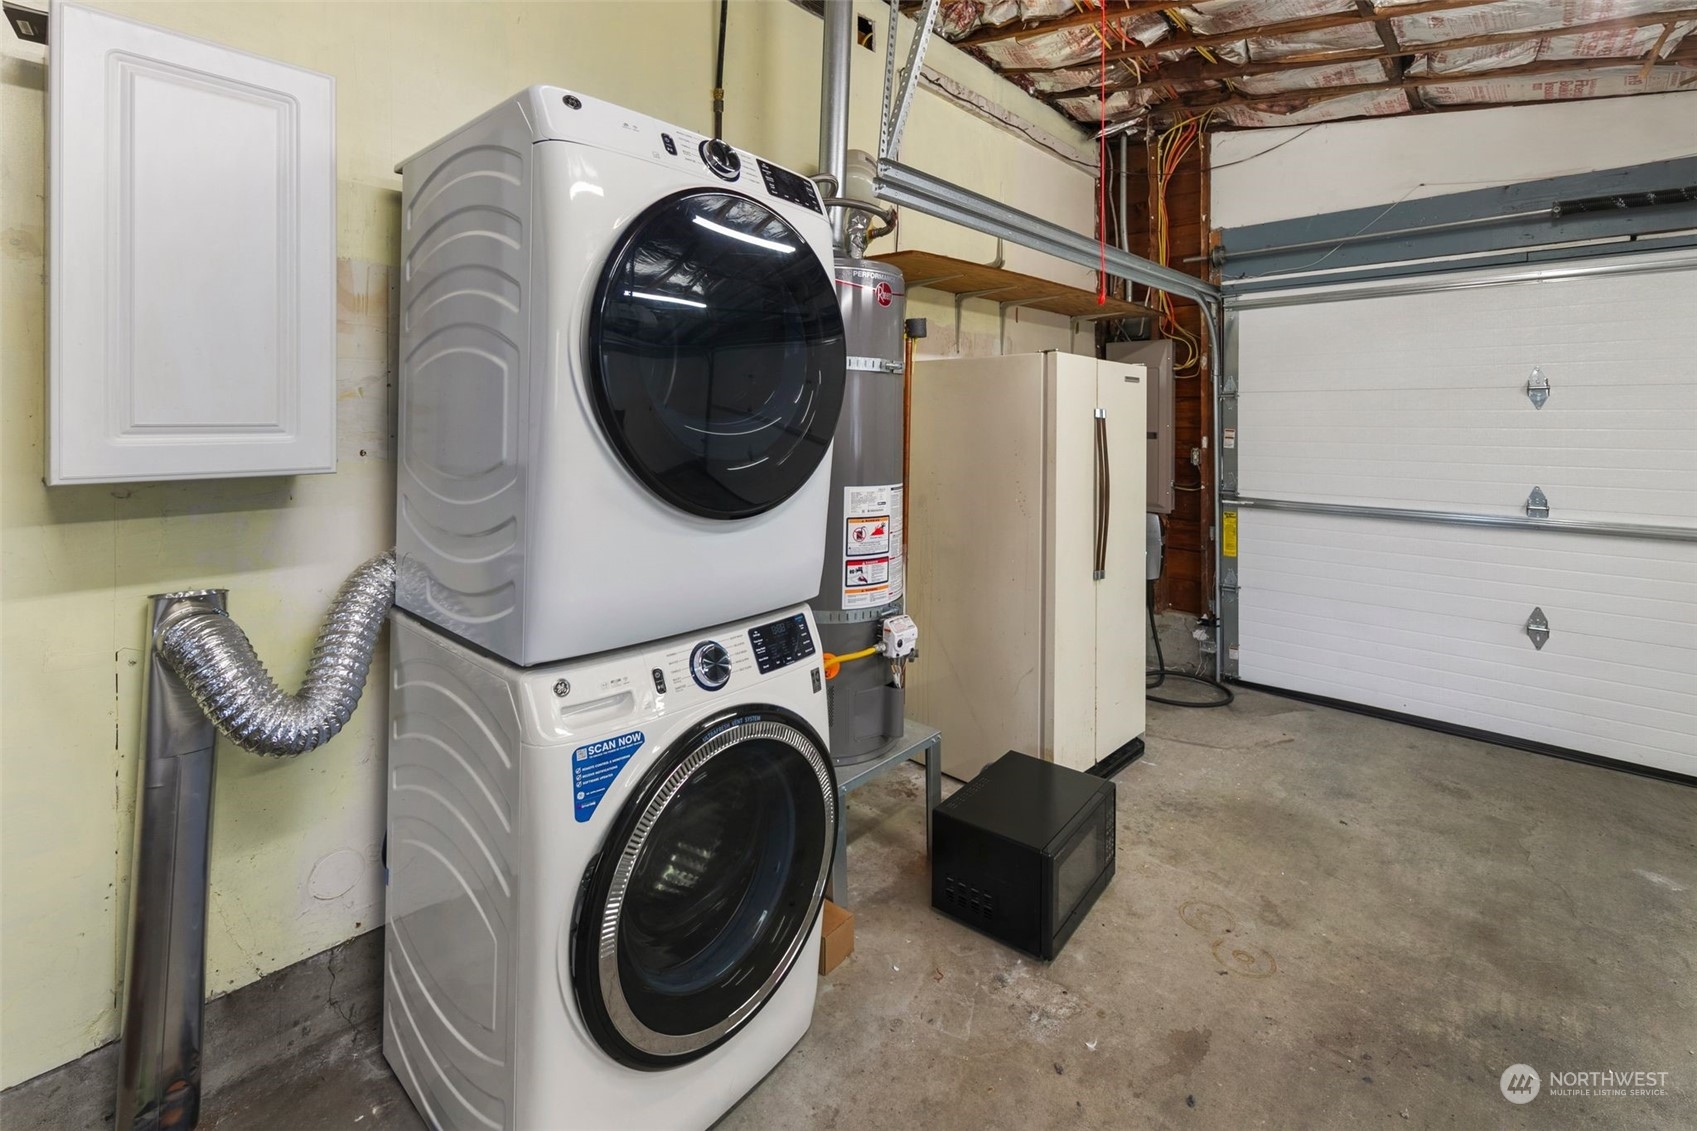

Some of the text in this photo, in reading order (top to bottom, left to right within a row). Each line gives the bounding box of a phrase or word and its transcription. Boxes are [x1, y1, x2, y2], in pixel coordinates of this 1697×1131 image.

[702, 715, 761, 742] ULTRAFRESH VENT SYSTEM
[588, 732, 642, 756] SCAN NOW
